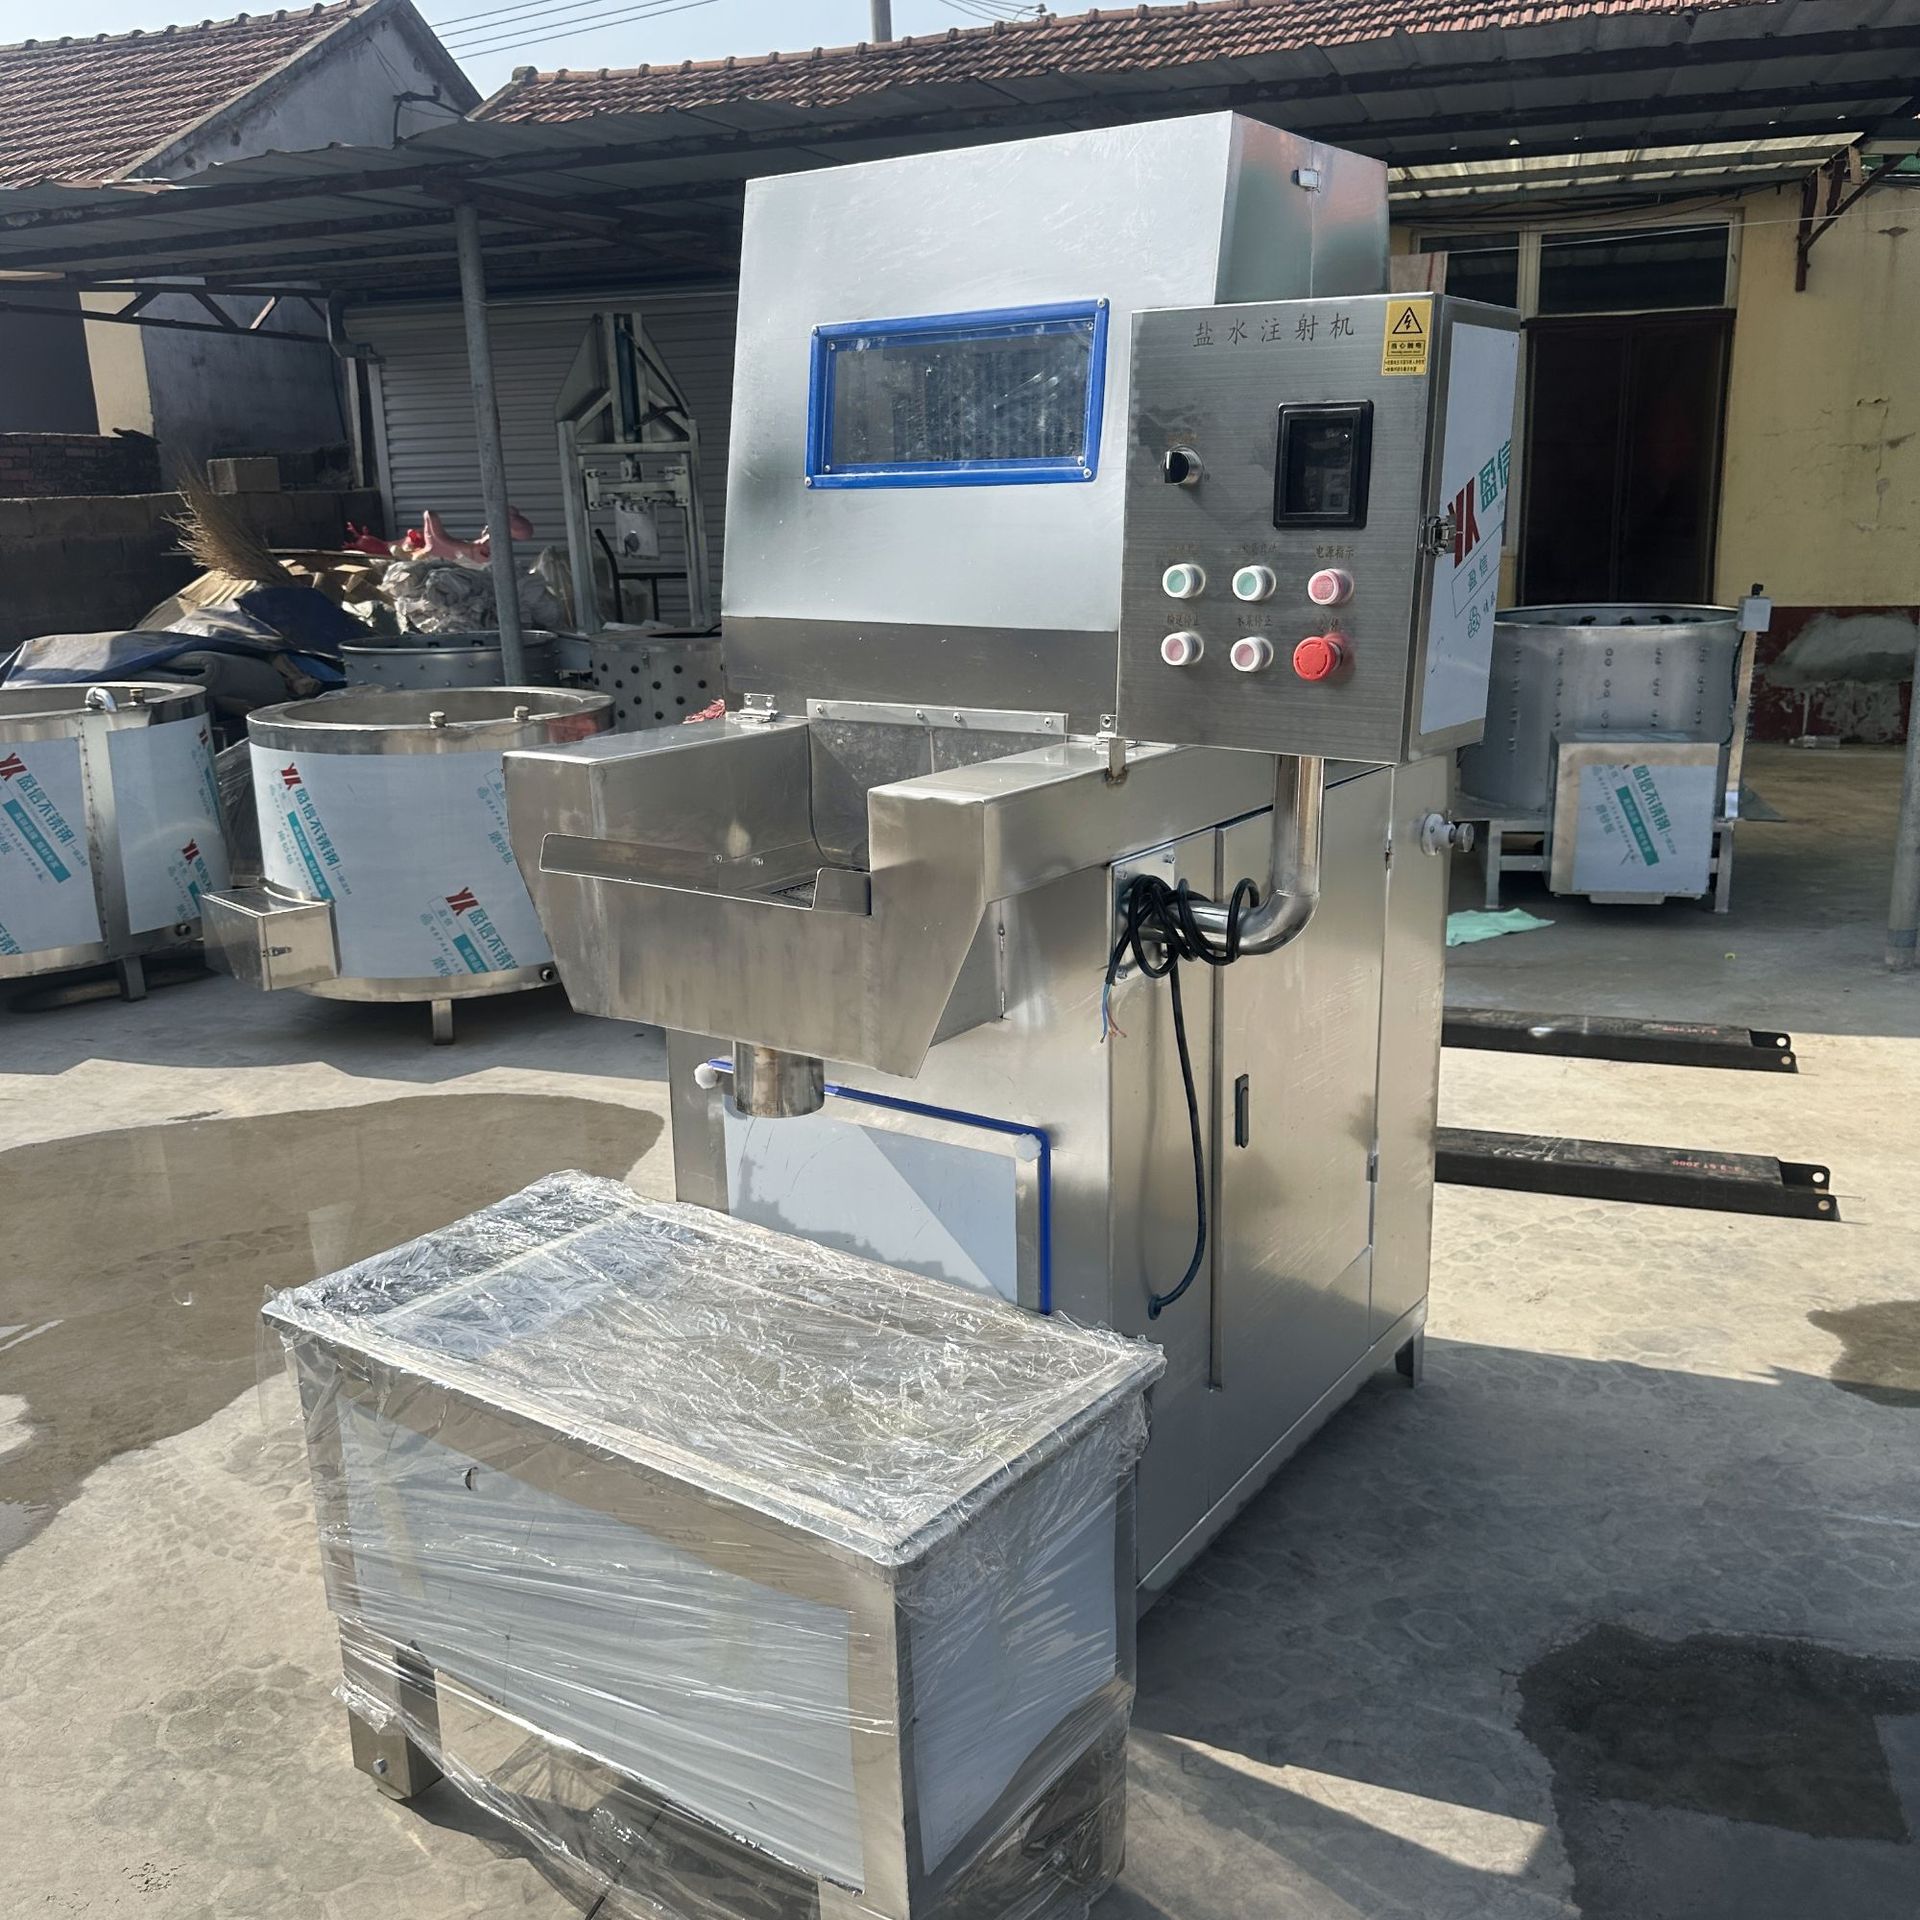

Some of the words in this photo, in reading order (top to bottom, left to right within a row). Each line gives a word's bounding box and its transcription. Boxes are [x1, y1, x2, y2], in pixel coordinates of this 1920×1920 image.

[1192, 312, 1355, 347] 盐水注射机
[17, 773, 75, 846] 盈信不锈钢
[295, 787, 341, 867] 盈信不锈钢
